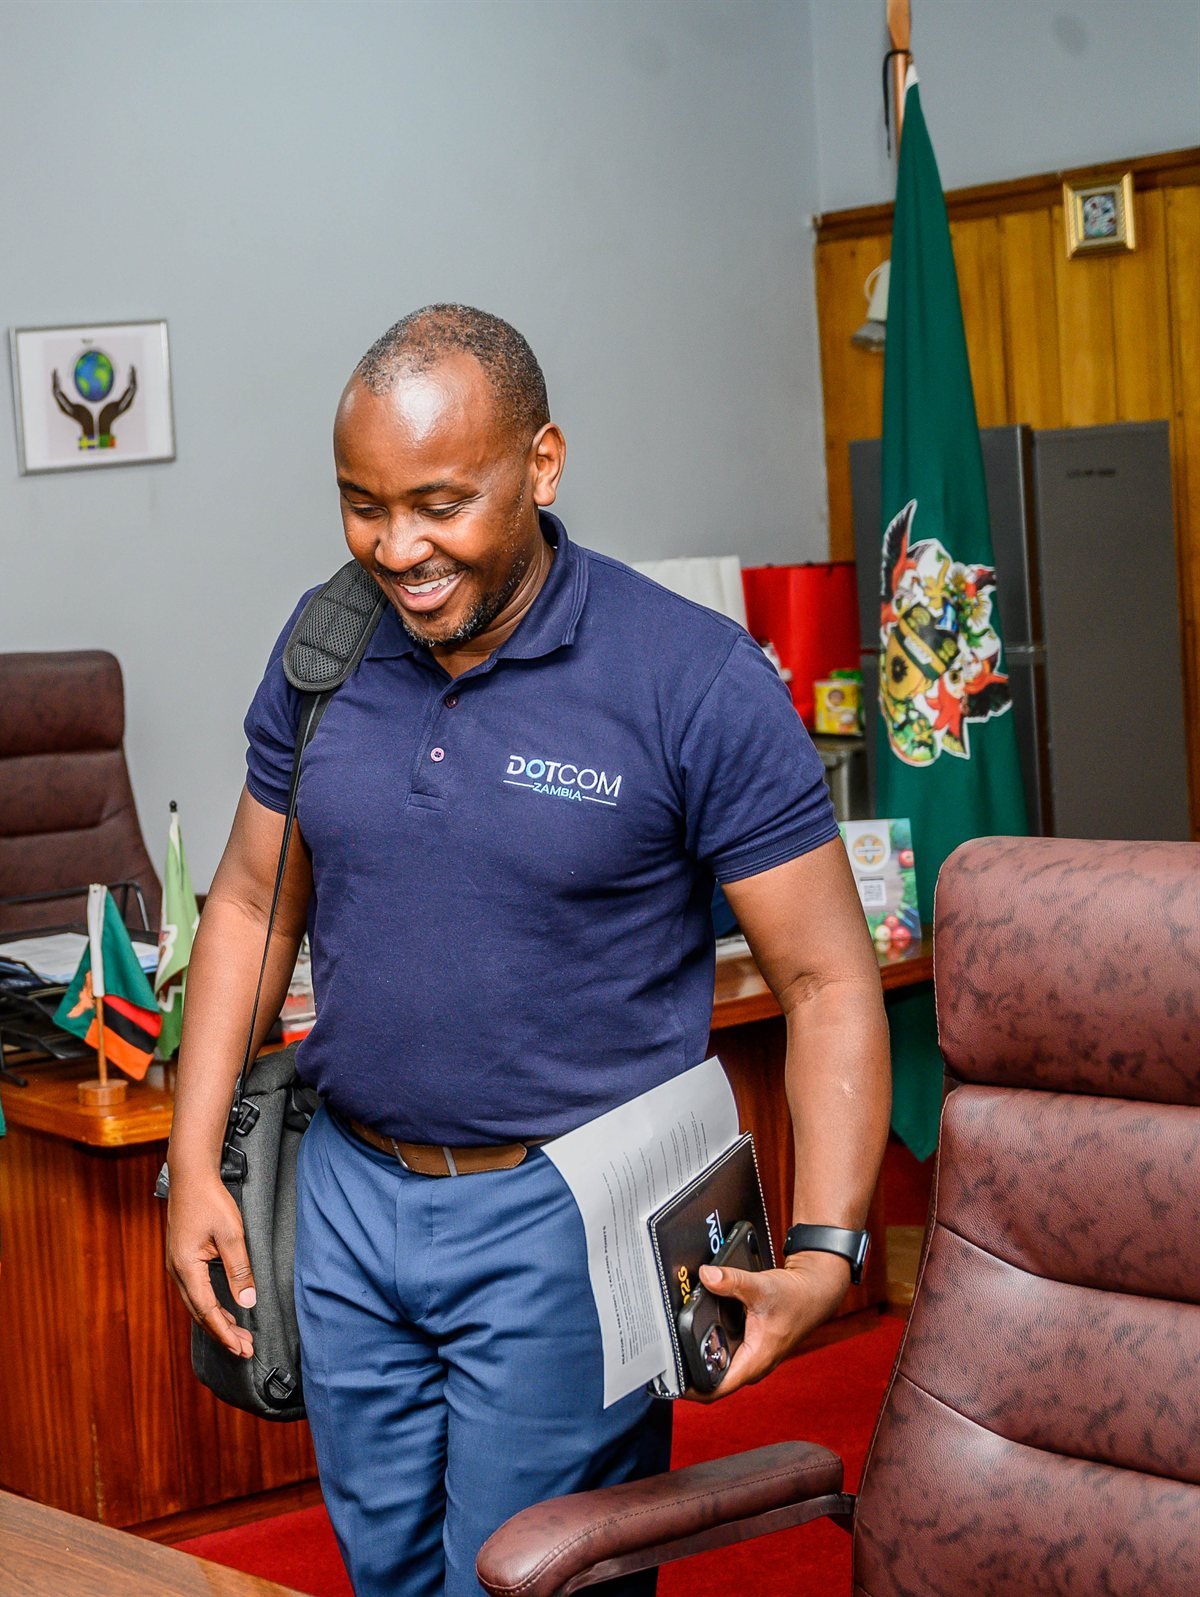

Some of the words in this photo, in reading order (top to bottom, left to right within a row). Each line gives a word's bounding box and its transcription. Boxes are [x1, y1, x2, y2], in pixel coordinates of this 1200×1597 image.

[506, 754, 622, 797] DOTCOM
[532, 782, 582, 802] ZAMBIA
[678, 1266, 691, 1304] 26
